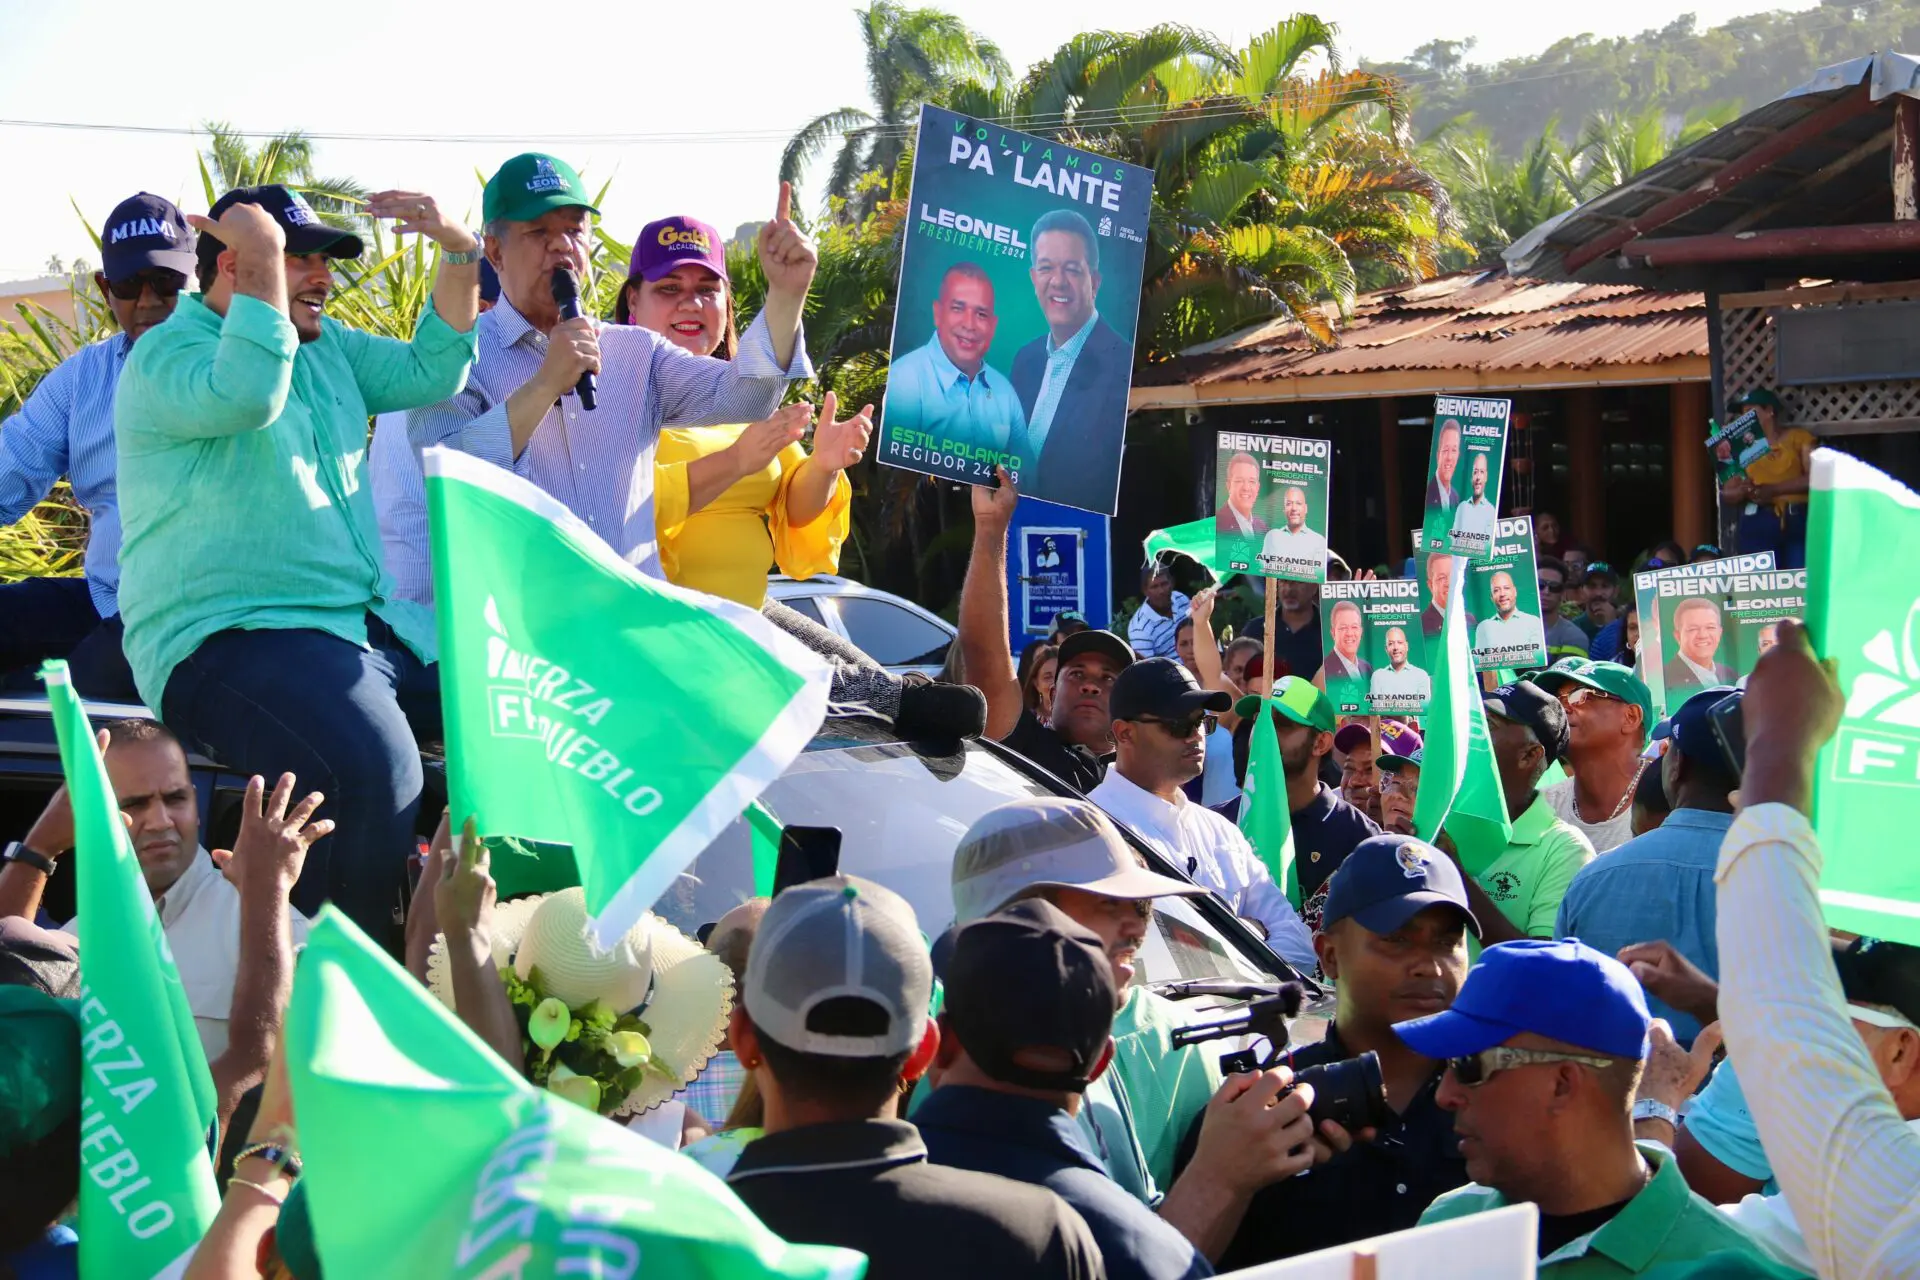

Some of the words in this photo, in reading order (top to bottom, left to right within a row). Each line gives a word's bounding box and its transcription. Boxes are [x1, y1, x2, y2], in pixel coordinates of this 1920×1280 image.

[955, 120, 1125, 181] VOLVAMOS
[111, 217, 177, 244] MIAMI
[921, 203, 1027, 249] LEONEL
[657, 226, 710, 248] Gabi
[918, 222, 1000, 257] PRESIDENTE
[1001, 246, 1026, 260] 2024
[1436, 398, 1507, 419] BIENVENIDO
[1462, 425, 1501, 437] LEONEL
[891, 426, 938, 451] ESTIL
[941, 438, 1022, 470] POLANCO
[1219, 433, 1327, 458] BIENVENIDO
[890, 441, 966, 472] REGIDOR
[973, 462, 1019, 485] 24-8
[1262, 460, 1324, 474] LEONEL
[1266, 470, 1315, 481] PRESIDENTE
[1449, 530, 1491, 541] ALEXANDER
[1430, 540, 1442, 548] FP
[1231, 562, 1249, 570] FP
[1256, 553, 1322, 568] ALEXANDER
[1321, 581, 1420, 599] BIENVENIDO
[1362, 603, 1420, 614] LEONEL
[1723, 597, 1807, 611] LEONEL
[1730, 608, 1799, 618] PRESIDENTE
[1471, 643, 1540, 656] ALEXANDER
[1342, 704, 1358, 712] FP
[1848, 738, 1920, 780] F
